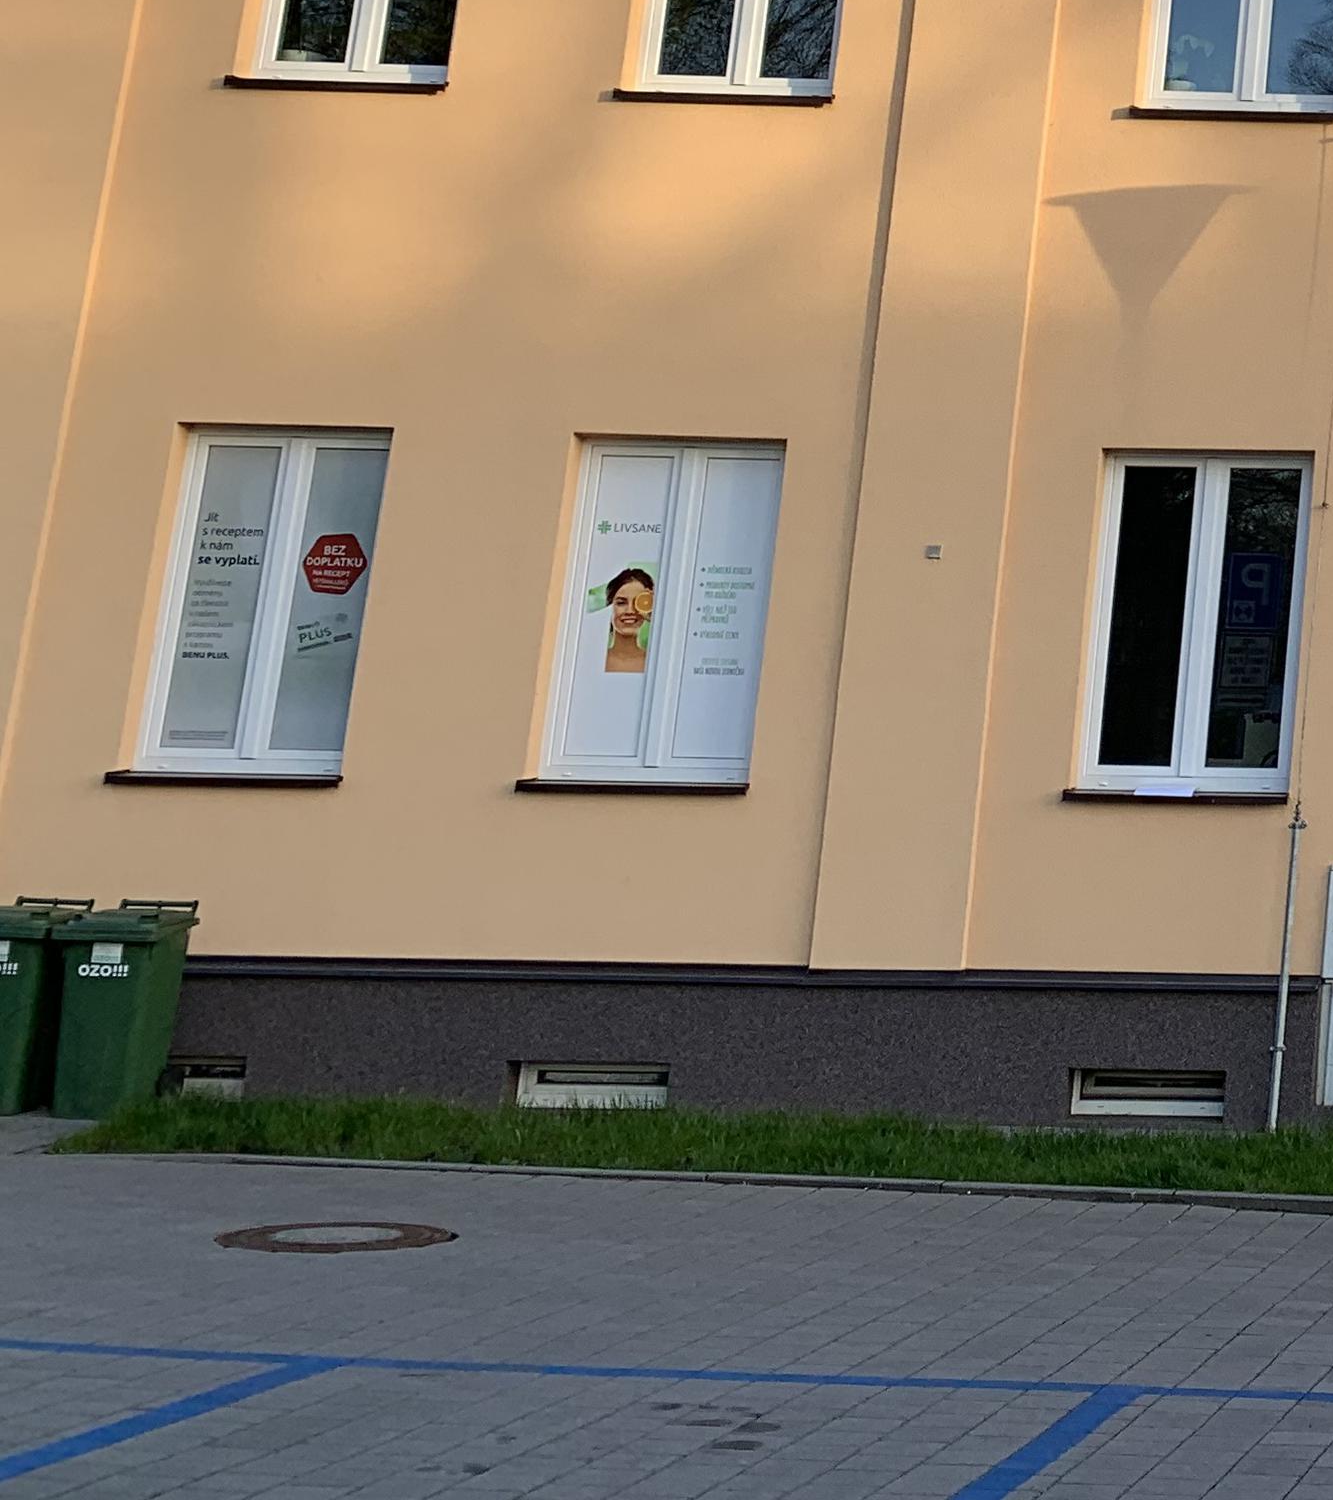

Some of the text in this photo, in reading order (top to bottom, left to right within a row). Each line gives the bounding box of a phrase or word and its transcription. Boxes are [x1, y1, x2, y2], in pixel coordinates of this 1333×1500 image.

[202, 527, 264, 538] s receptem
[613, 523, 662, 534] LIVSANE
[209, 540, 234, 551] nám
[323, 545, 347, 556] BEZ
[197, 555, 212, 565] se
[306, 556, 364, 568] DOPLATKU
[323, 569, 351, 578] RECEPT
[299, 627, 333, 644] PLUS
[78, 964, 130, 977] OZO!!!
